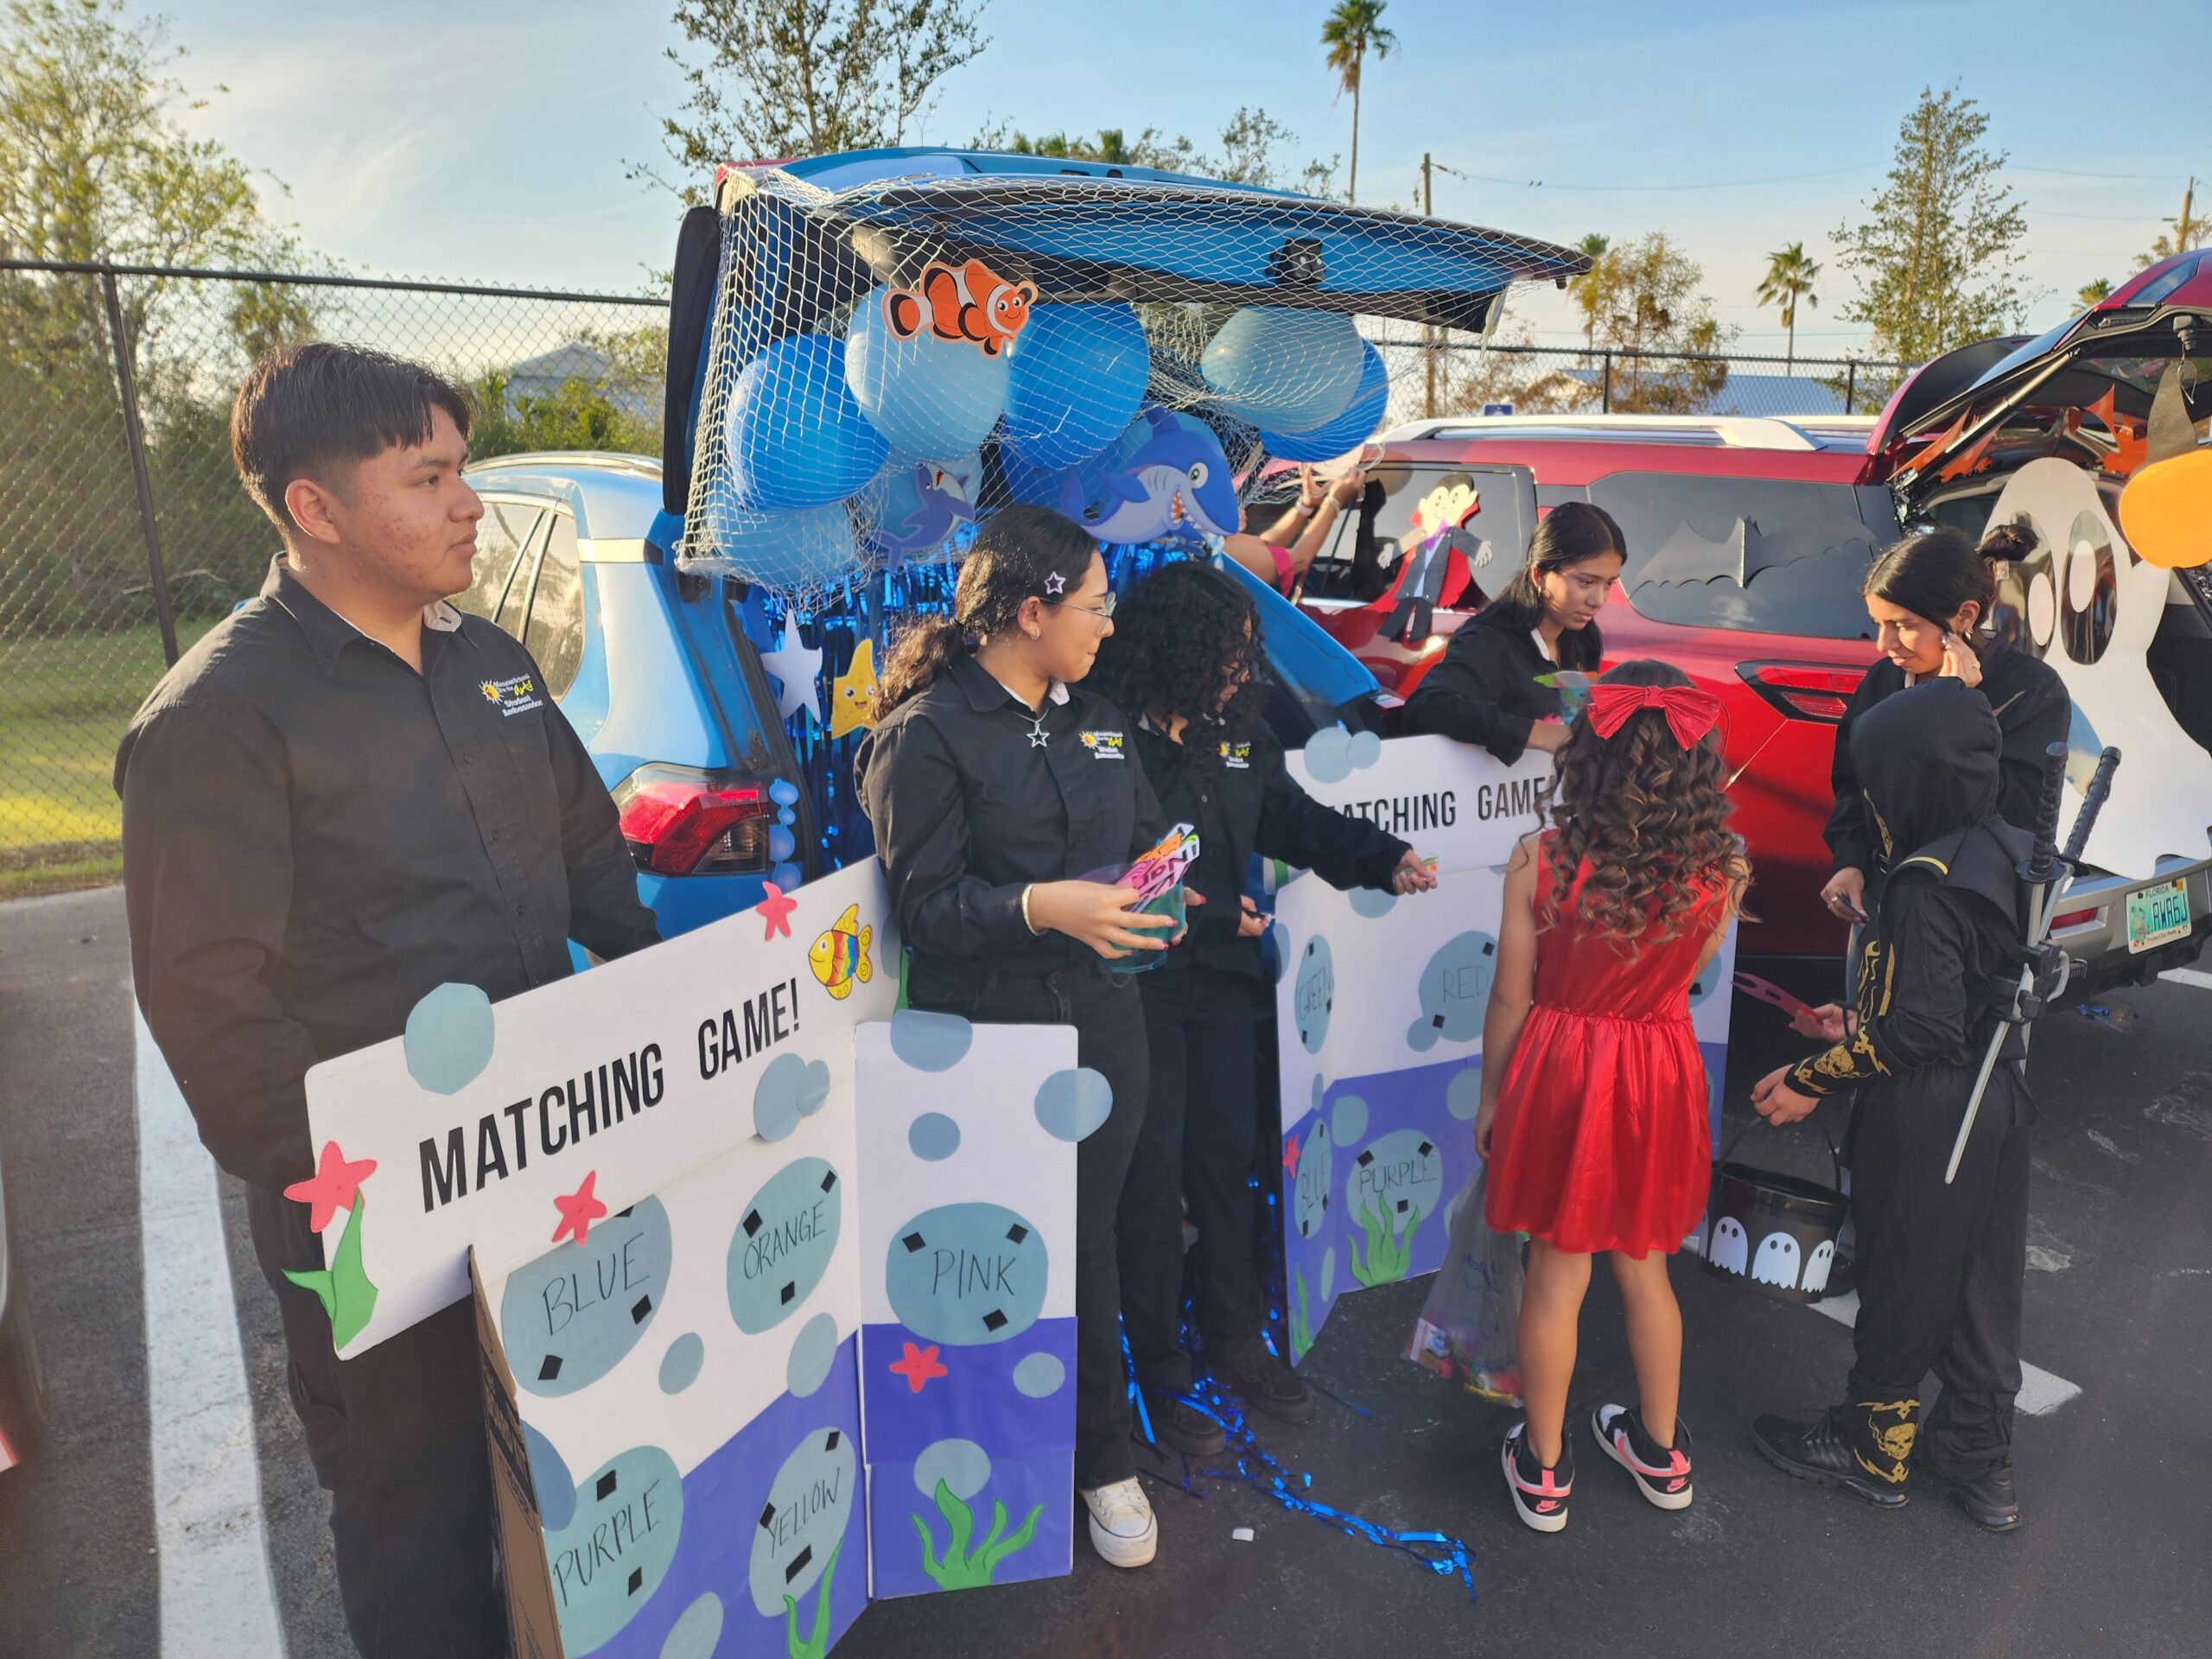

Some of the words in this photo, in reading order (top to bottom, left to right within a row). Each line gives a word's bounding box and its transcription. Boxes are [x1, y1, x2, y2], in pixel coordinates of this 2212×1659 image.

[1327, 790, 1457, 834] TCHING
[2145, 884, 2170, 899] FLORIDA
[1443, 965, 1490, 1003] RED
[419, 1042, 664, 1214] MATCHING
[696, 976, 800, 1081] GAME!
[1359, 1154, 1437, 1195] PURPLE
[743, 1200, 827, 1281] ORANGE
[541, 1231, 651, 1337] BLUE
[933, 1249, 1016, 1300] PINK
[552, 1478, 661, 1608] PURPLE
[766, 1466, 841, 1560] YELLOW
